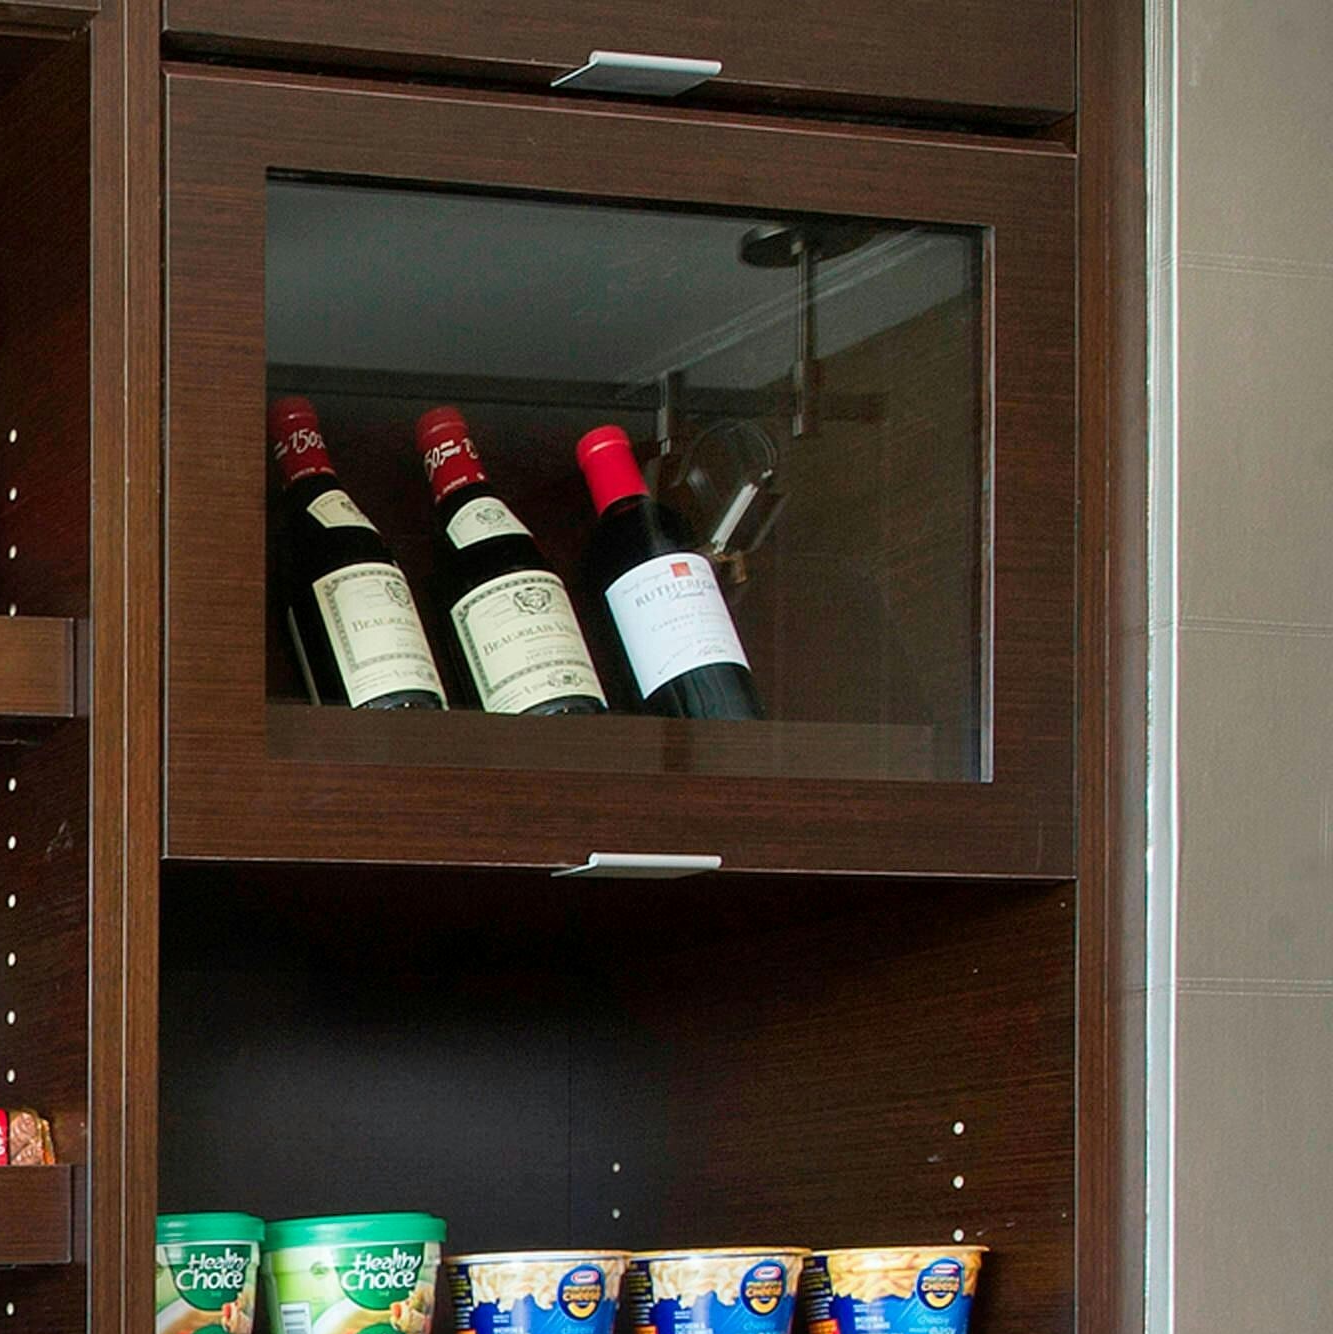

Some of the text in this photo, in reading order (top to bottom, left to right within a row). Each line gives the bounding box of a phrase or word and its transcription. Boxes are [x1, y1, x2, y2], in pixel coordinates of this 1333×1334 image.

[188, 1248, 250, 1272] Healthy
[353, 1247, 422, 1271] Healthy
[175, 1267, 244, 1291] Choice
[340, 1267, 417, 1291] Choice
